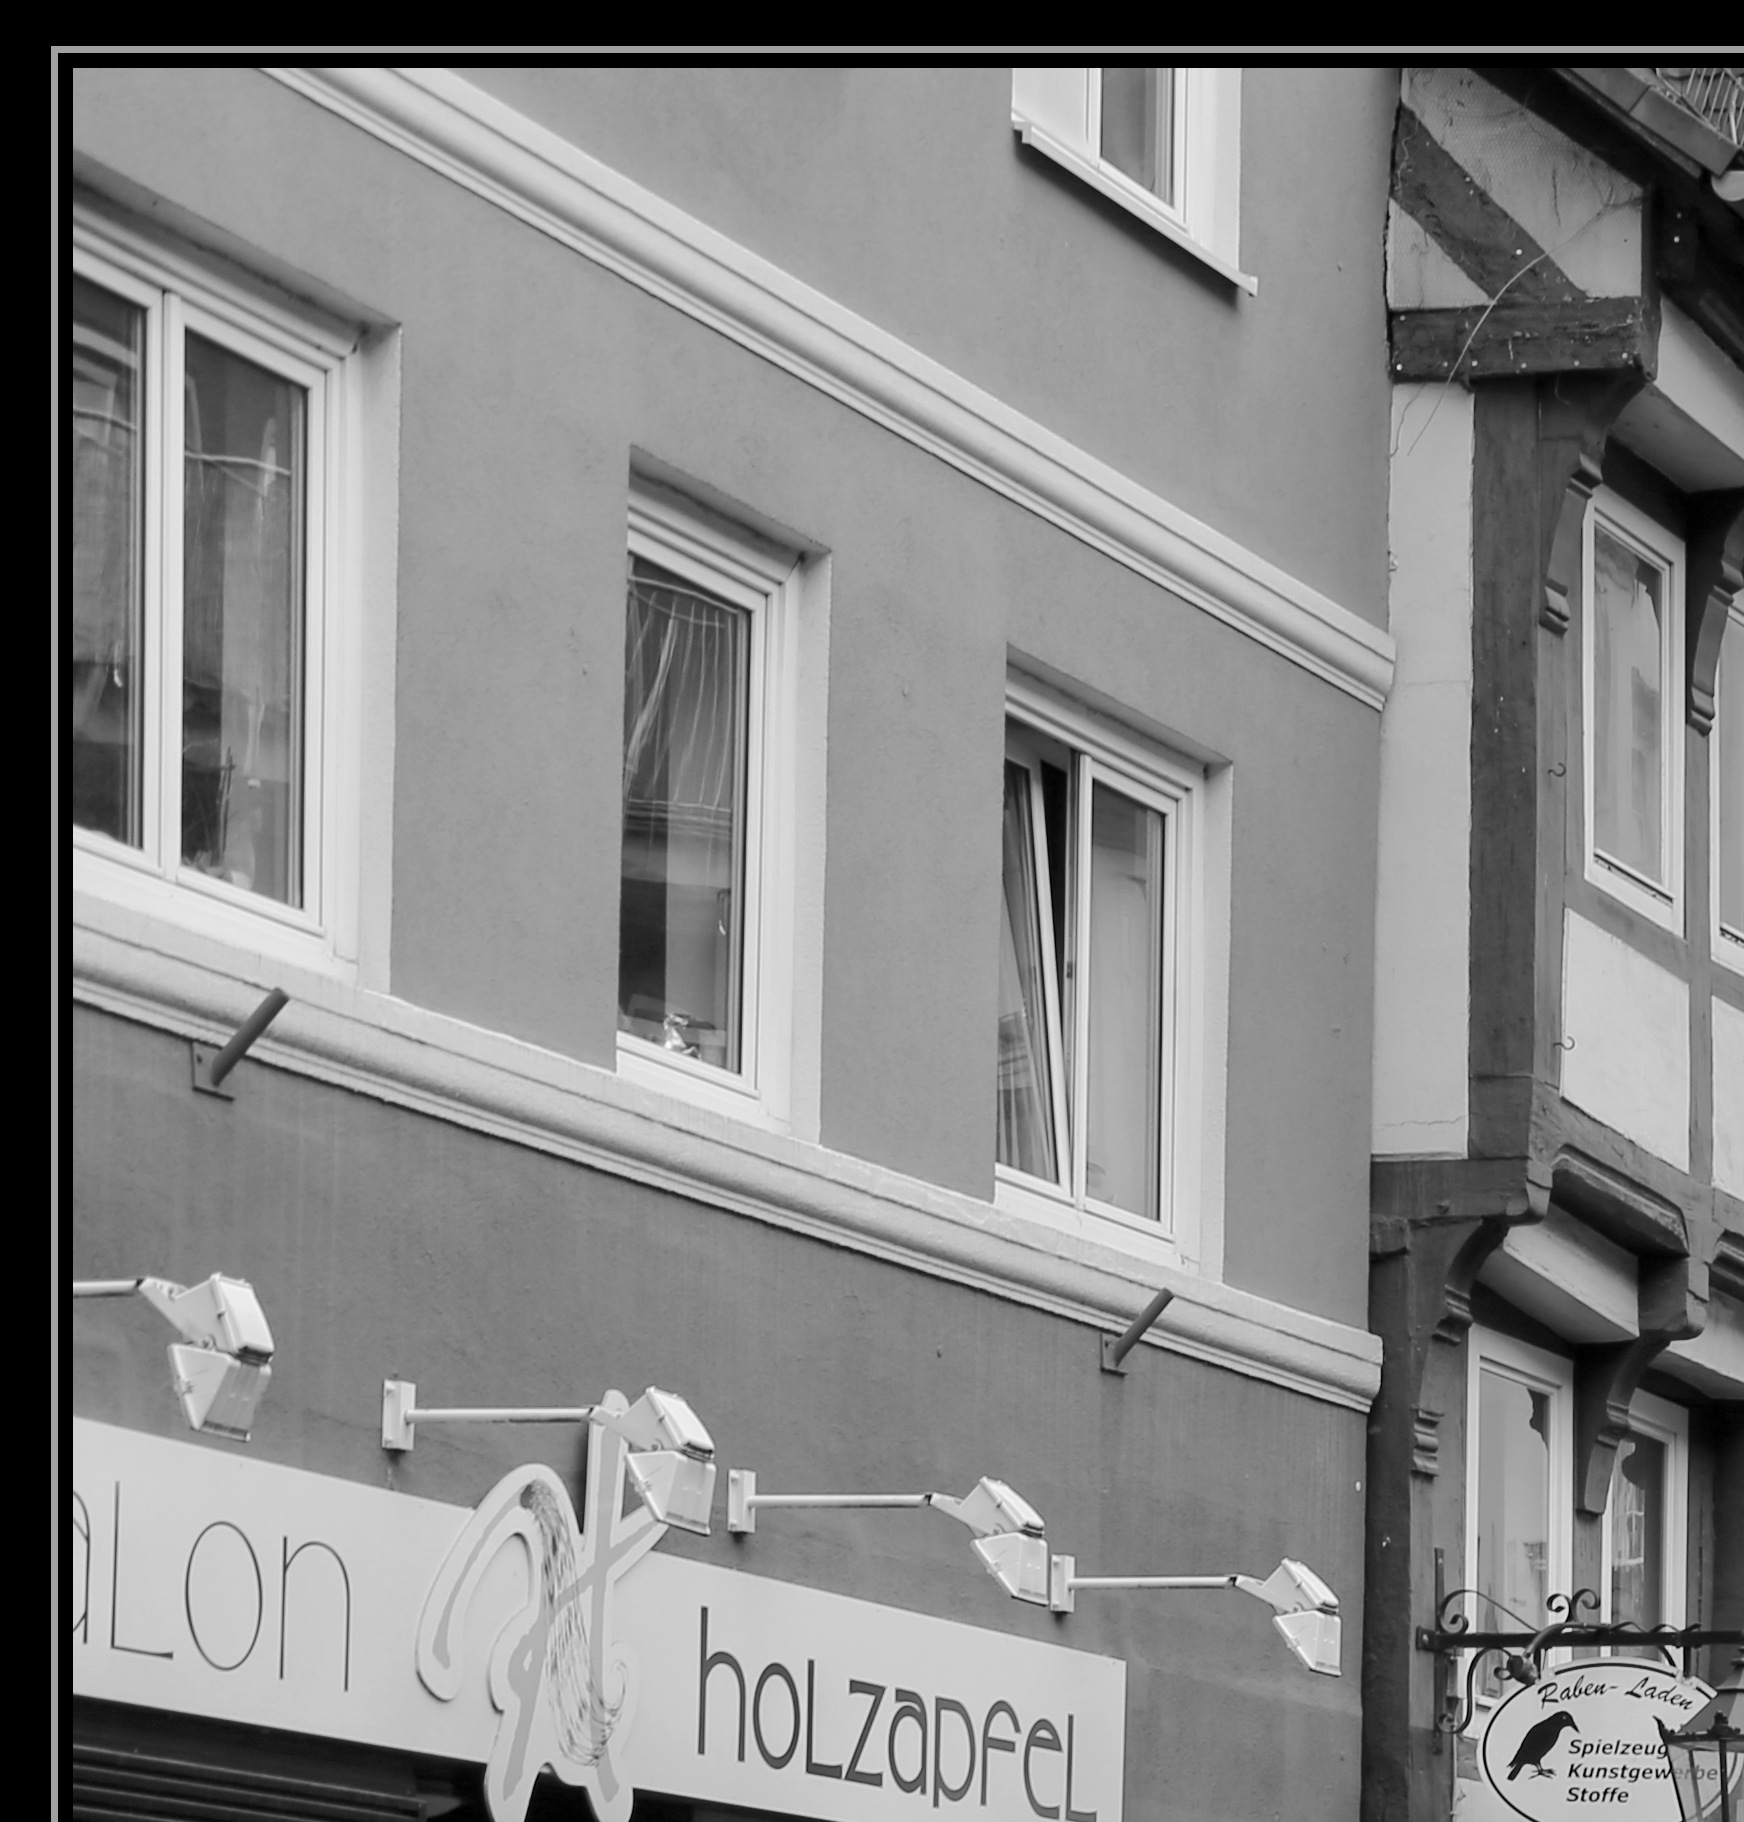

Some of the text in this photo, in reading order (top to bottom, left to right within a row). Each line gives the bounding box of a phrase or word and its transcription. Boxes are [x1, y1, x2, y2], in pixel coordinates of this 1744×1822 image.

[1625, 1676, 1693, 1710] Laden
[1568, 1739, 1668, 1759] Spielzeug
[1568, 1763, 1718, 1783] Kunstgewerbe
[1566, 1787, 1629, 1803] Stoffe
